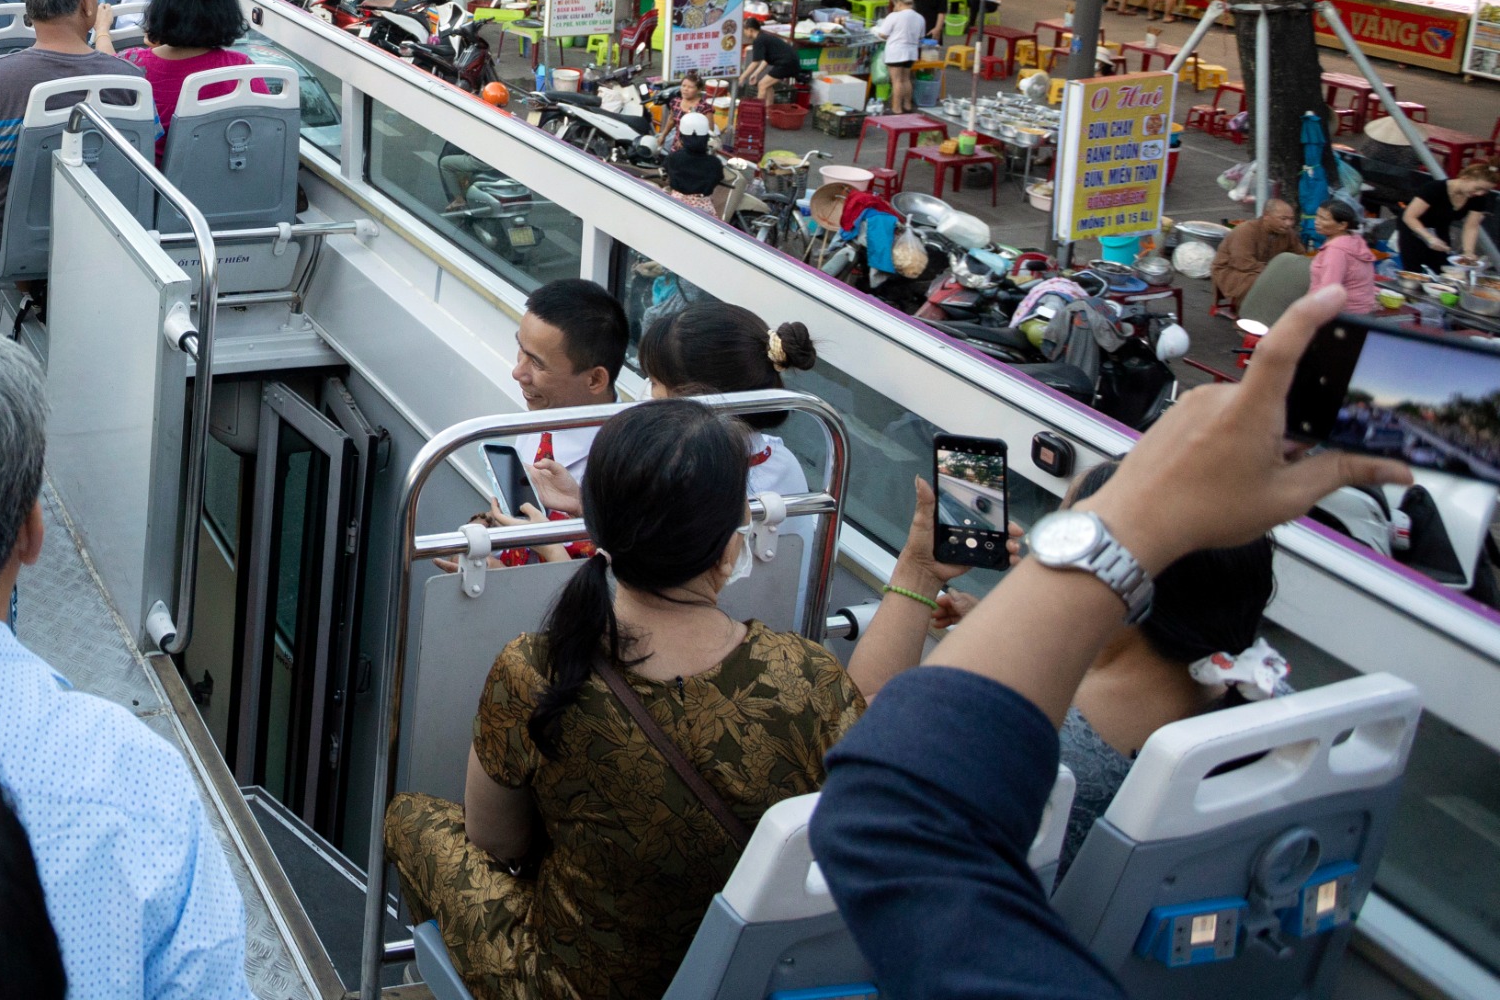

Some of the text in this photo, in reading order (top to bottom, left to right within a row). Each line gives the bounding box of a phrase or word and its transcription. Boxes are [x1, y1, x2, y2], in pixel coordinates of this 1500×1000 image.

[1350, 8, 1420, 48] VÀNG
[1091, 87, 1109, 112] O
[1088, 118, 1135, 140] BÚN CHAY
[1086, 144, 1112, 164] BÁNH
[177, 258, 188, 267] ỐI
[225, 254, 250, 265] HIỂM
